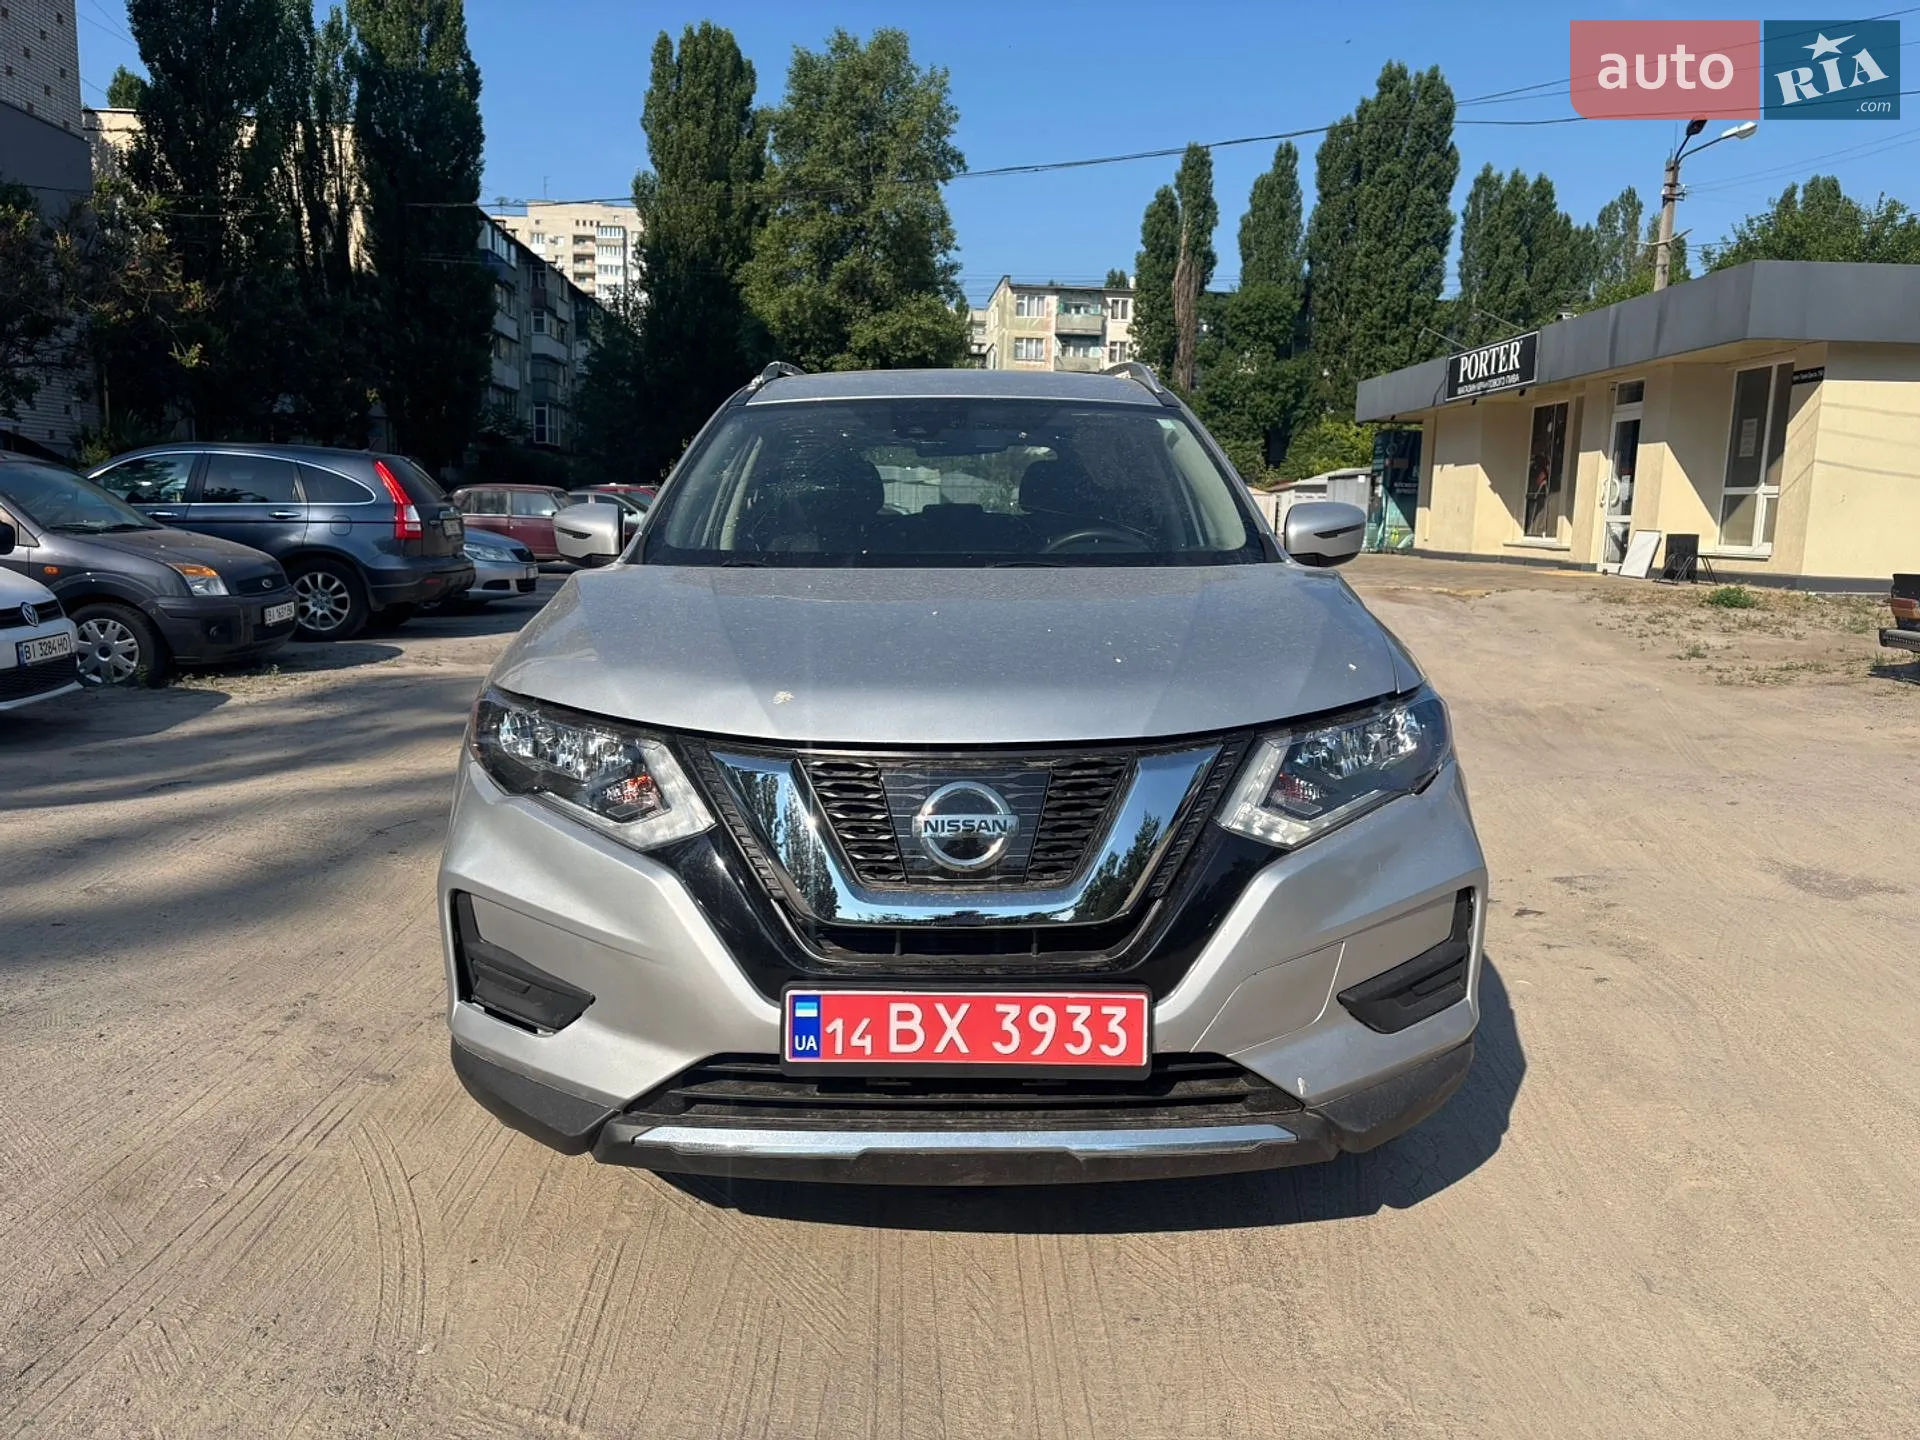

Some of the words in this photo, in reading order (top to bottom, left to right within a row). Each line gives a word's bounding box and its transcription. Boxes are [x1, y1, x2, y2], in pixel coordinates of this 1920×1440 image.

[1458, 341, 1520, 383] PORTER
[924, 819, 1007, 833] NISSAN
[795, 1035, 818, 1051] UA
[825, 1017, 873, 1056] 14
[888, 1002, 971, 1055] BX
[992, 1003, 1127, 1057] 3933
